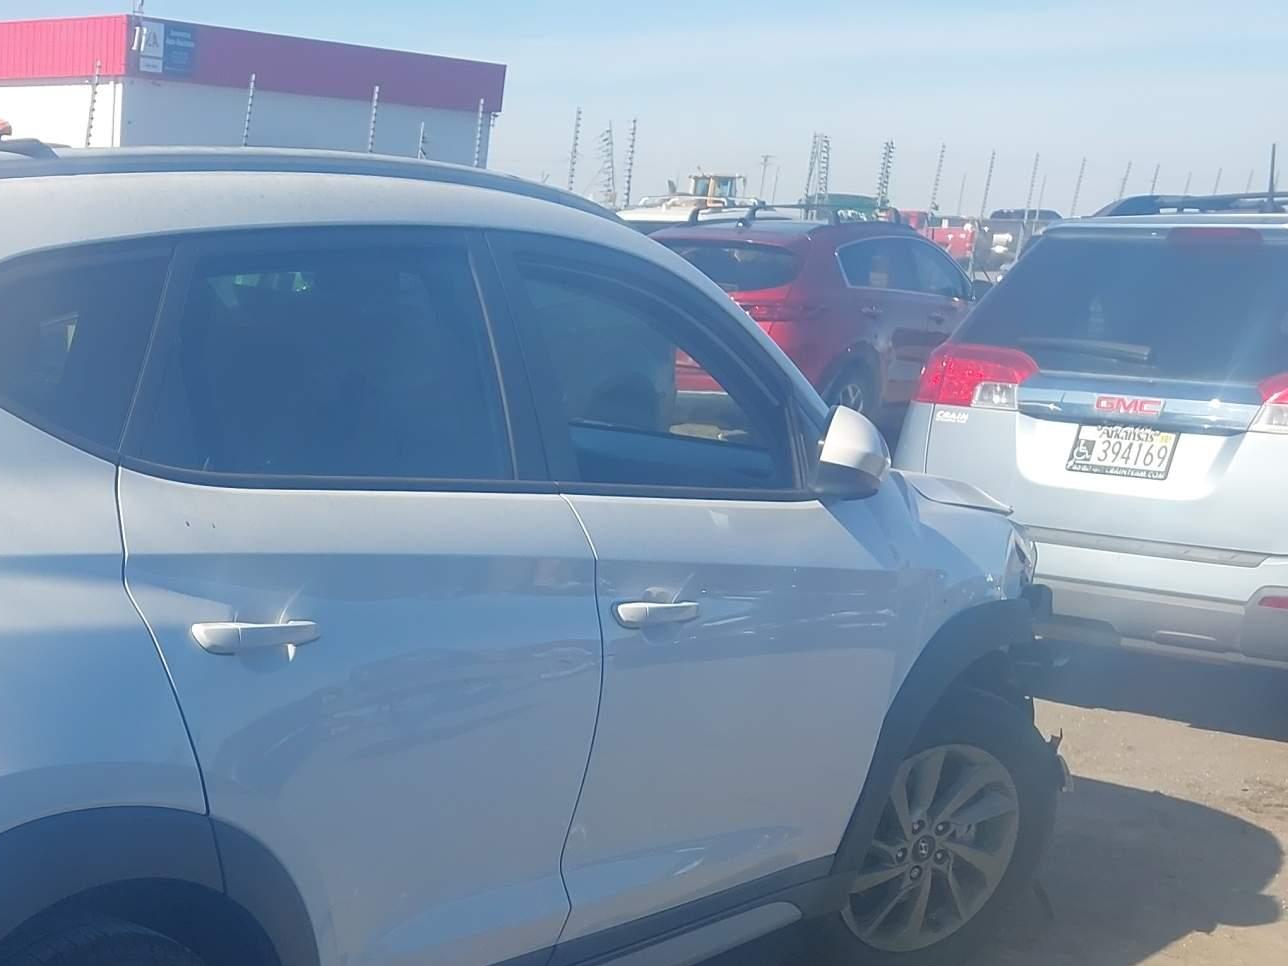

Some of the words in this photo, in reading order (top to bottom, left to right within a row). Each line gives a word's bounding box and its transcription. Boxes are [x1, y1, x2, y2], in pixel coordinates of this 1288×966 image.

[1095, 396, 1162, 414] GMC
[1098, 428, 1154, 443] Arkansas
[1097, 439, 1168, 468] 394169
